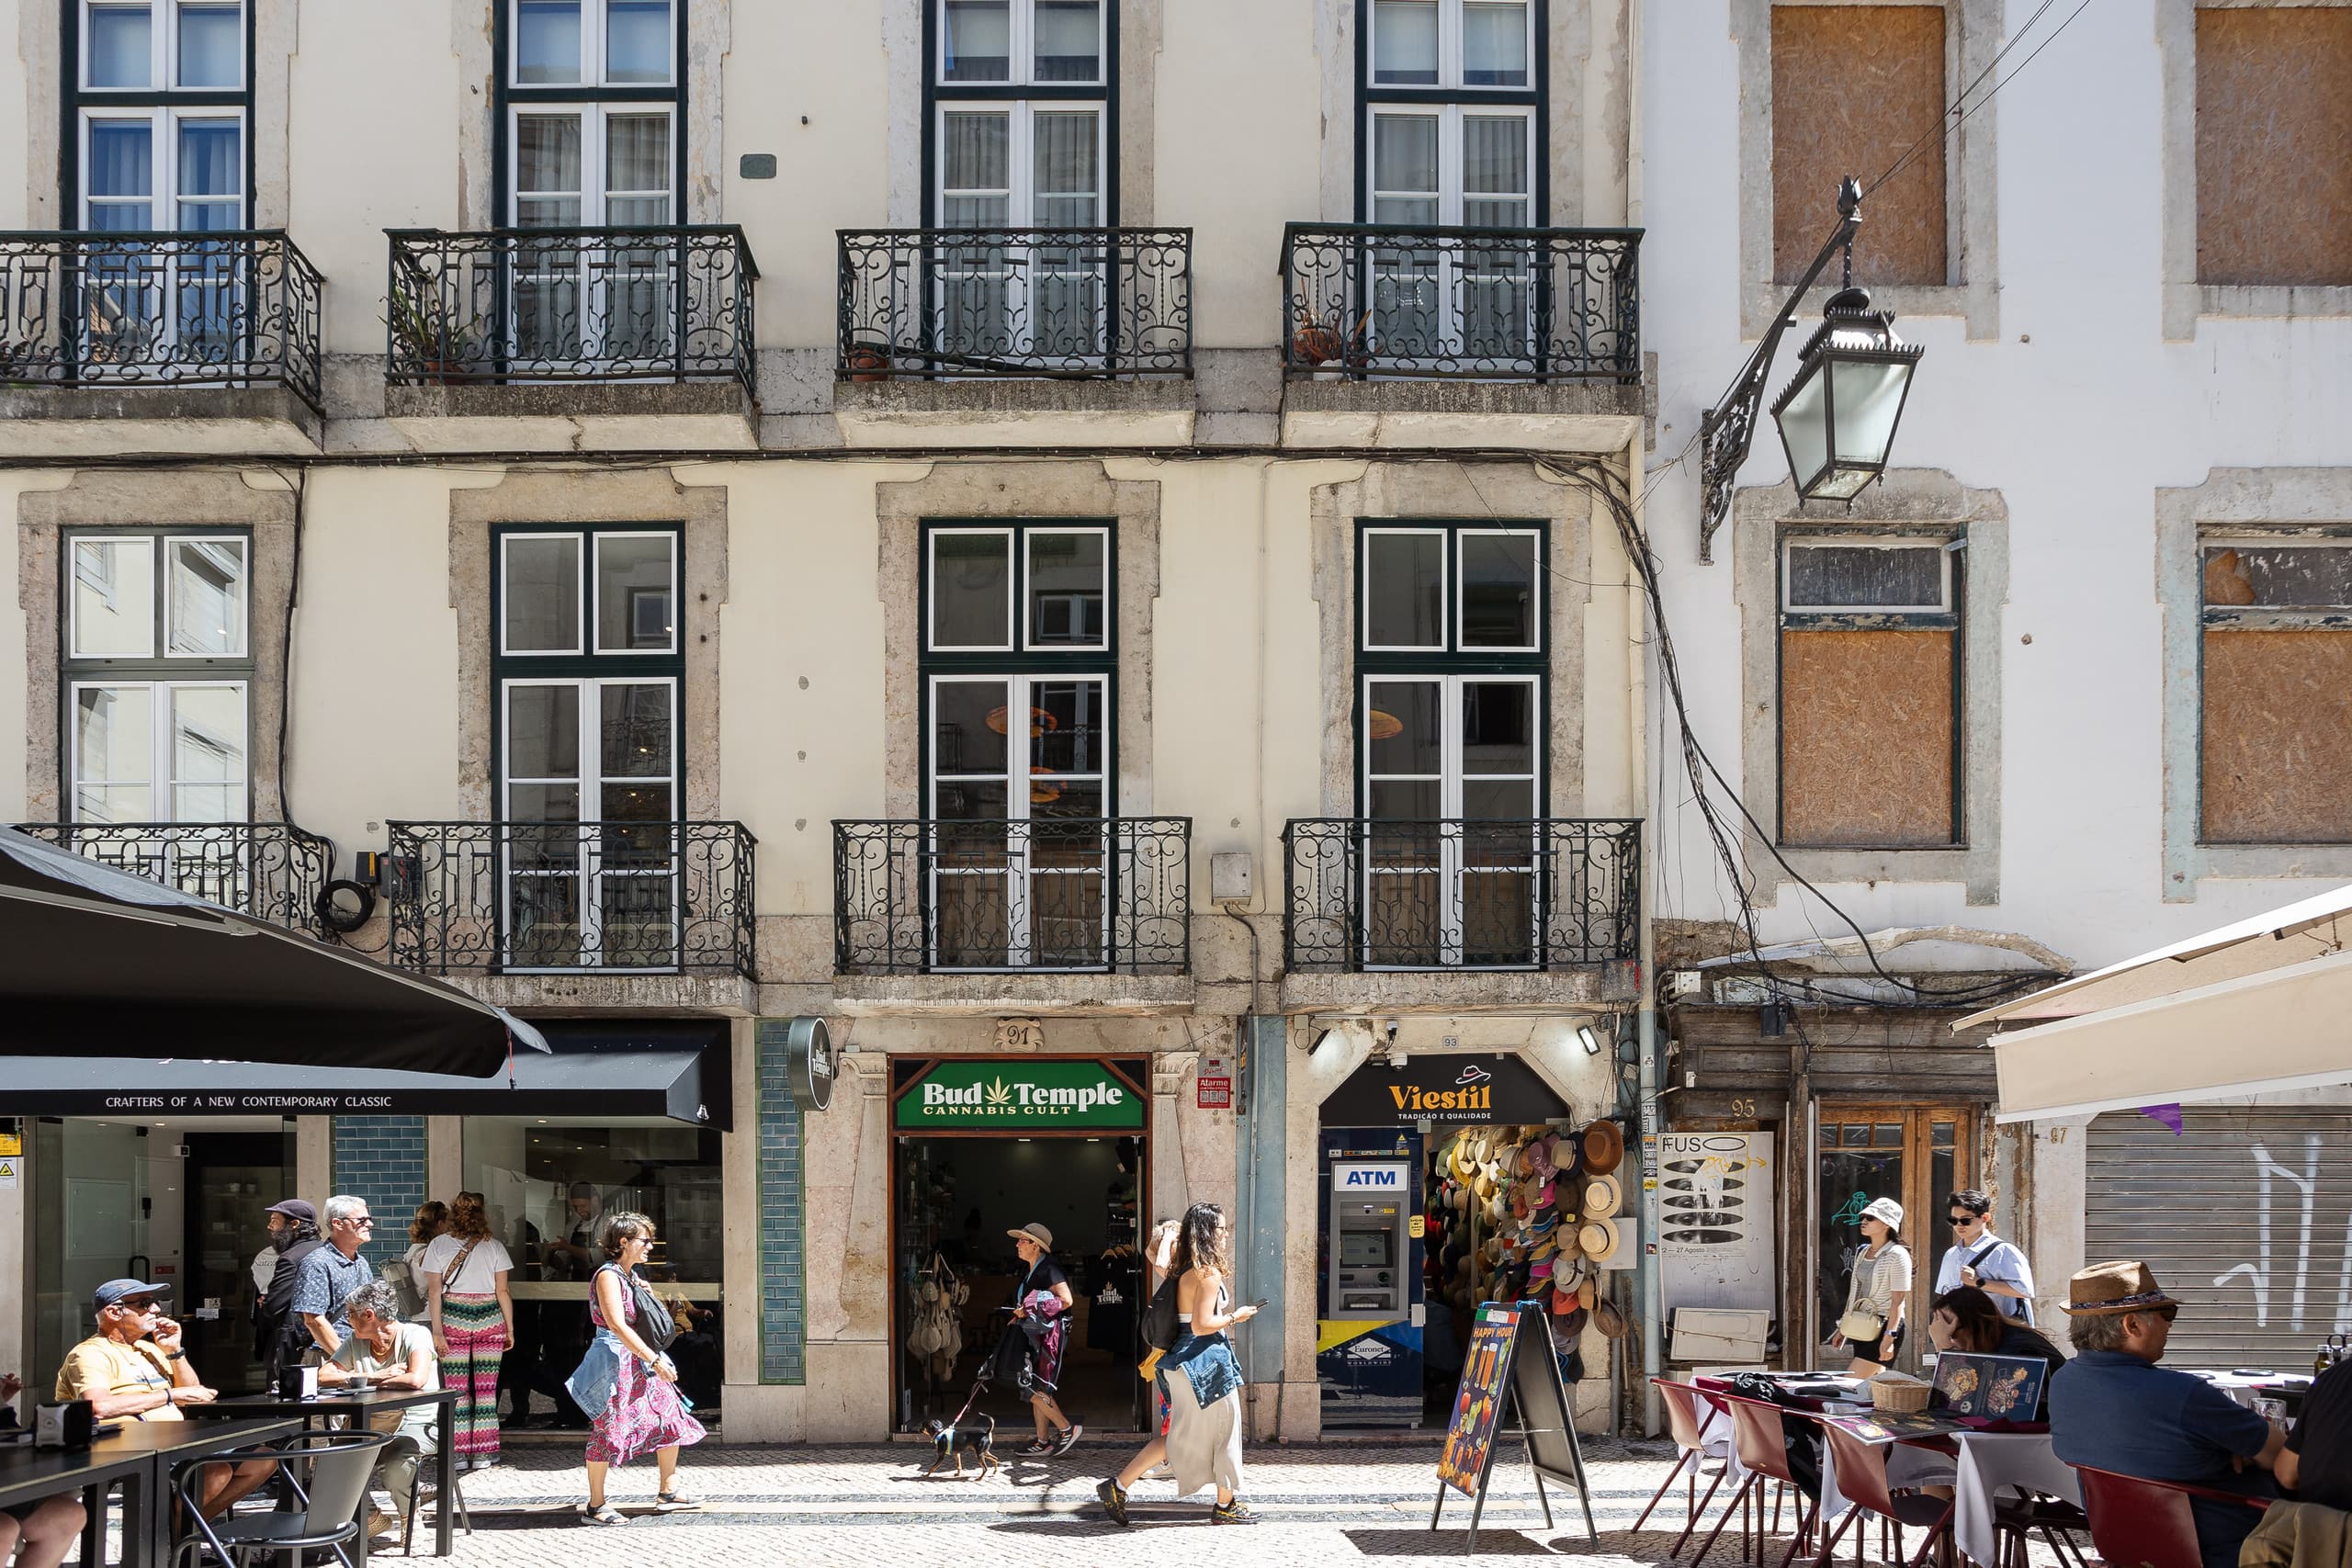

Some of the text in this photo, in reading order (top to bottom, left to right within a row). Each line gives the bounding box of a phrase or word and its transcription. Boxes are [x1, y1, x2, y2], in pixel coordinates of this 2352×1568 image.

[1007, 1025, 1029, 1045] 91
[1444, 1038, 1457, 1047] 93
[1200, 1078, 1228, 1087] Alarme
[106, 1097, 392, 1108] CRAFTERS OF A NEW CONTEMPORARY CLASSIC
[923, 1081, 1123, 1112] Bud Temple
[1388, 1085, 1491, 1110] Viestil
[922, 1106, 1071, 1115] CANNABIS CULT
[1732, 1098, 1755, 1117] 95
[2050, 1127, 2069, 1144] 97
[1662, 1136, 1747, 1152] FUSO
[1346, 1170, 1396, 1185] ATM
[1473, 1326, 1514, 1338] HAPPY HOUR
